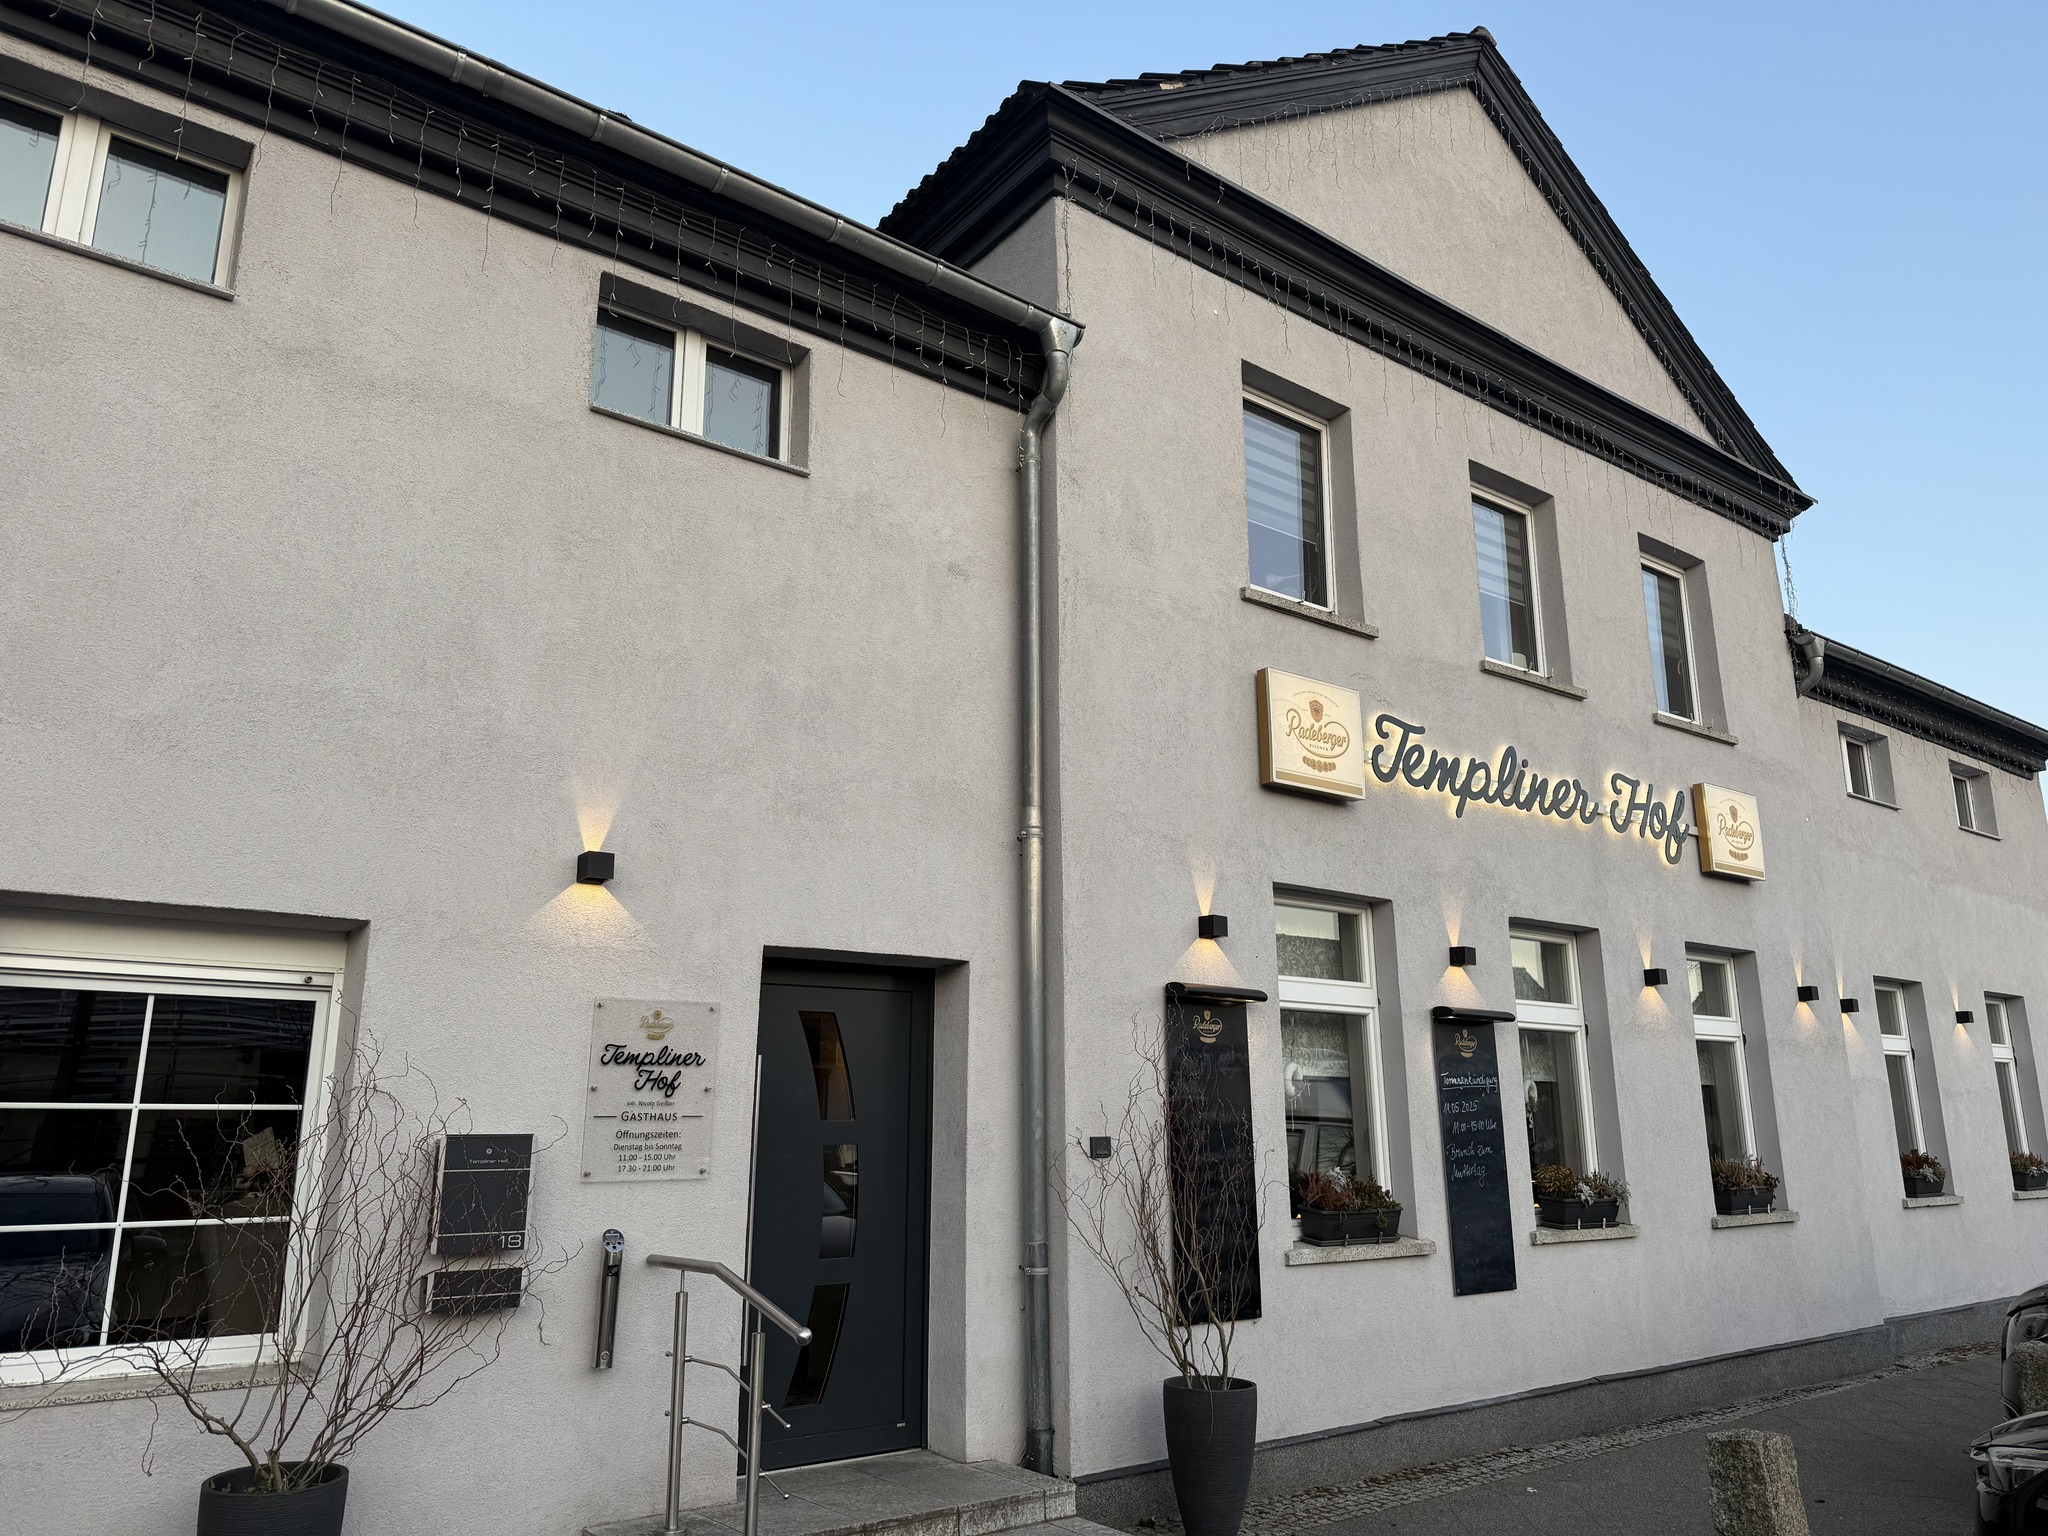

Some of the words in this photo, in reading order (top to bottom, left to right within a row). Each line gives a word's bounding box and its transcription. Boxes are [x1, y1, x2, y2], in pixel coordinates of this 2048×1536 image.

[1286, 708, 1349, 753] Radeberger
[1371, 713, 1599, 824] Templiner
[1610, 772, 1689, 865] Hof
[600, 1043, 706, 1071] Templiner
[634, 1069, 682, 1098] Hof
[621, 1111, 678, 1122] GASTHAUS
[615, 1129, 682, 1140] Öffnungszeiten:
[613, 1143, 642, 1151] Dienstag
[655, 1142, 683, 1151] Sonntag
[618, 1153, 637, 1161] 11.00
[643, 1153, 662, 1161] 15.00
[663, 1153, 676, 1161] Uhr
[618, 1164, 637, 1172] 17.30
[642, 1164, 661, 1172] 21.00
[497, 1234, 521, 1249] 18
